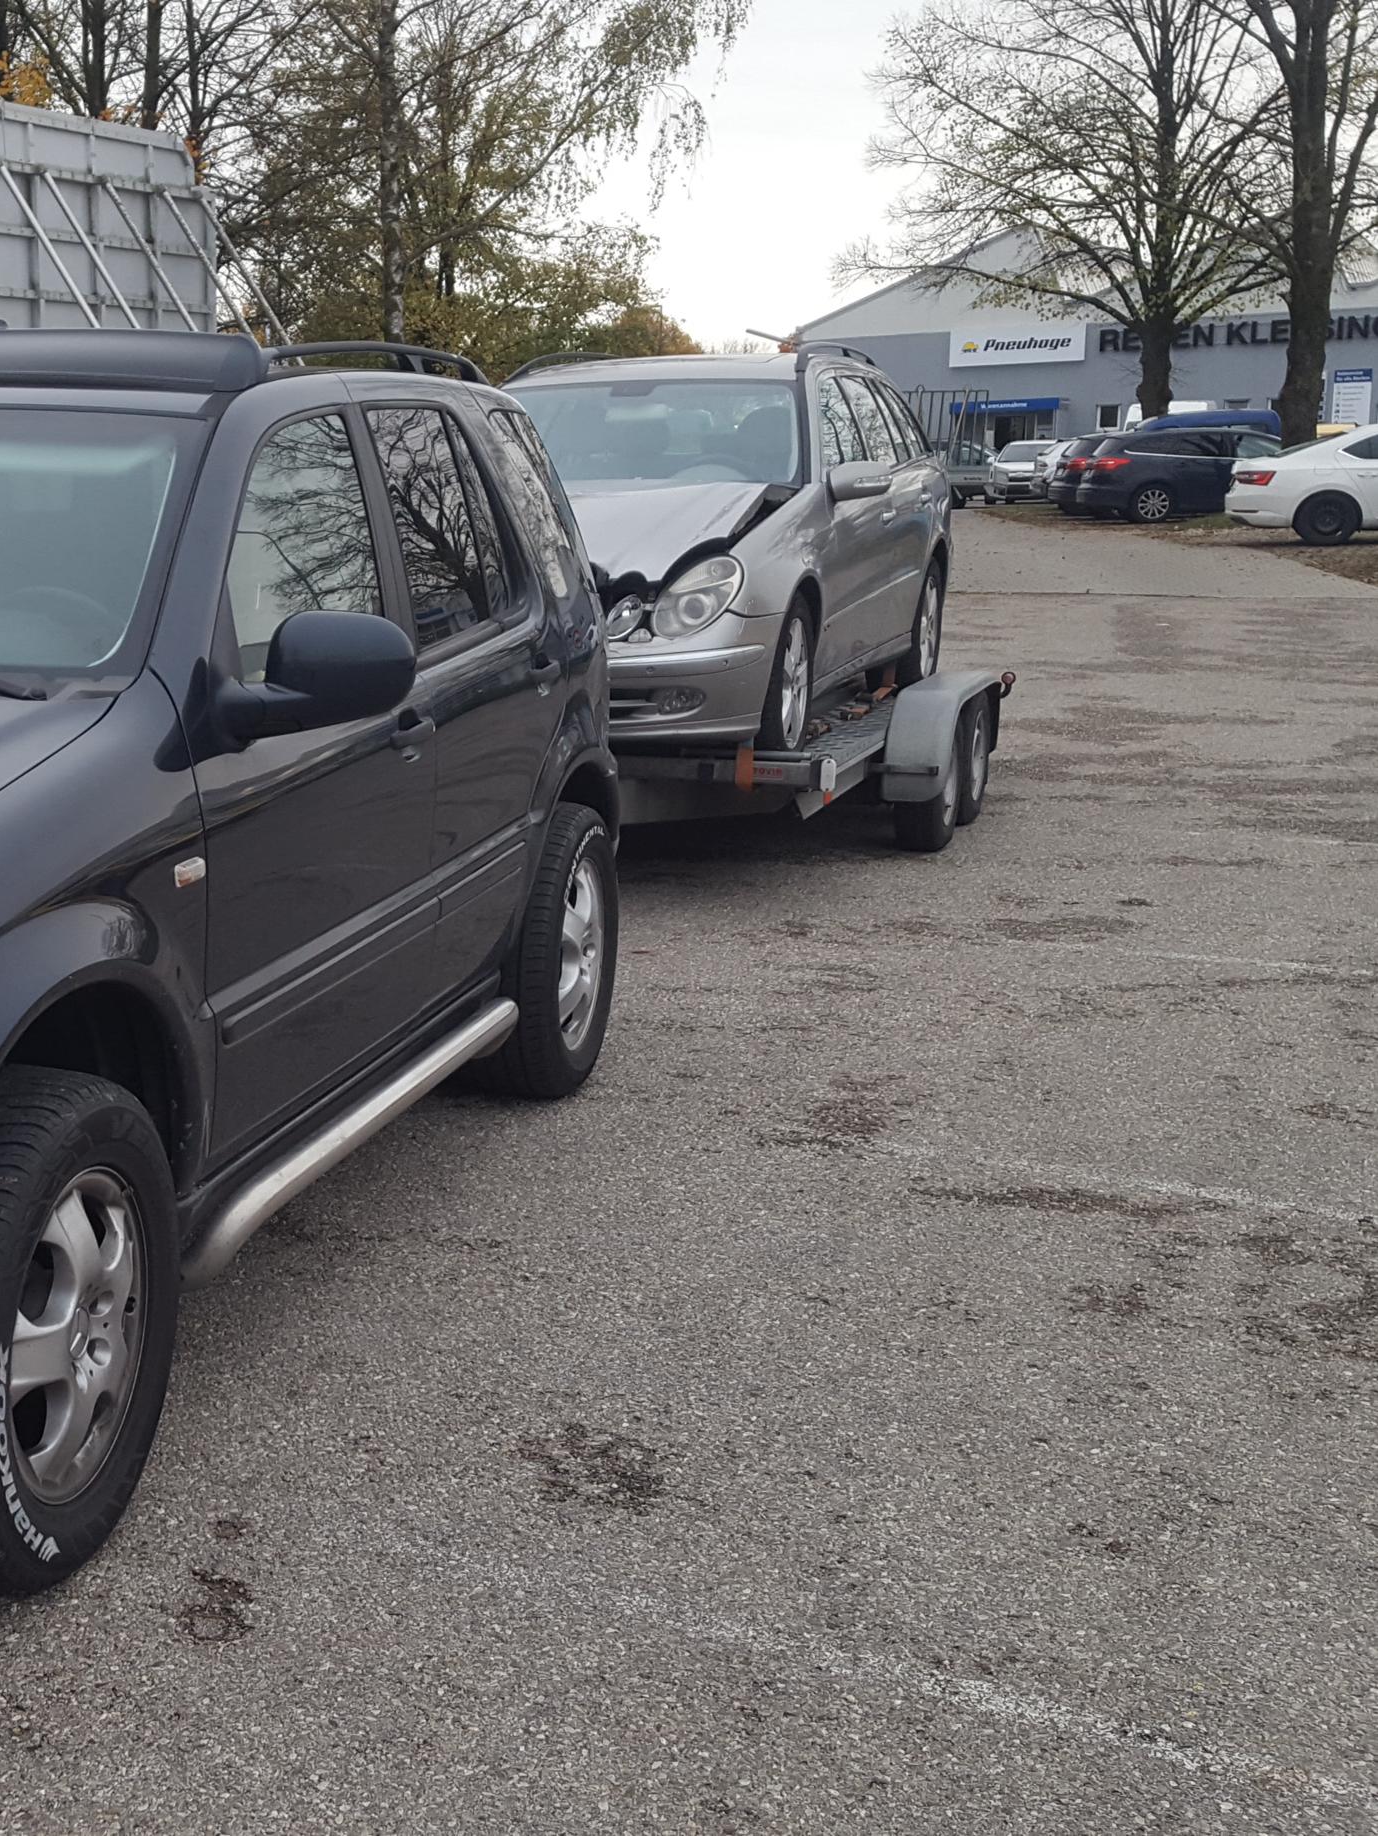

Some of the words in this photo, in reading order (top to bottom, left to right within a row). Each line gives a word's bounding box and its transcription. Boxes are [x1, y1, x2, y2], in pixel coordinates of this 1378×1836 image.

[983, 337, 1072, 351] Pneuhage
[1099, 323, 1215, 352] REEN
[563, 825, 605, 905] CONTINENTAL
